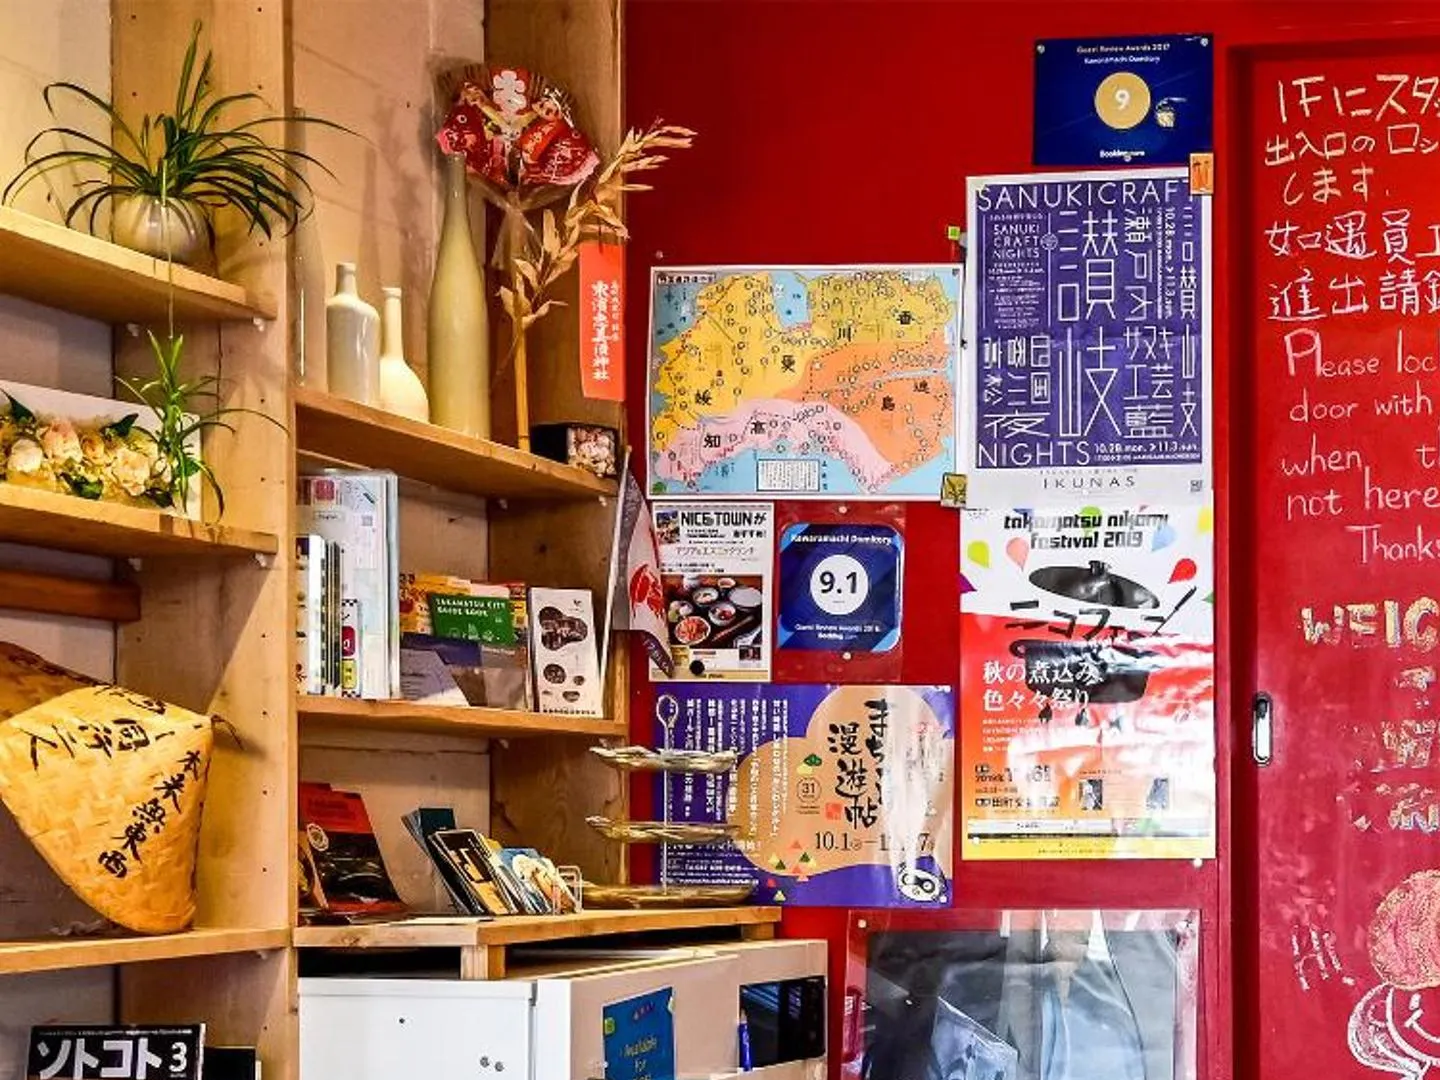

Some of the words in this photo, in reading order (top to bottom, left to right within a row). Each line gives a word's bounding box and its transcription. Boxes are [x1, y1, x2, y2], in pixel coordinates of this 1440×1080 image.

[1115, 89, 1130, 110] 9
[994, 223, 1040, 235] SANUKI
[993, 247, 1040, 259] NIGHTS
[994, 235, 1040, 248] CRAFT
[1284, 328, 1380, 378] Please
[1289, 389, 1359, 423] door
[1374, 380, 1434, 416] with
[978, 440, 1091, 468] NIGHTS
[1281, 432, 1363, 477] when
[1044, 476, 1136, 490] IKUNAS
[1286, 489, 1344, 521] not
[1004, 509, 1103, 532] takamatsu
[1031, 532, 1099, 550] festival
[1103, 531, 1144, 549] 2019
[819, 571, 859, 595] 9.1
[983, 656, 1104, 686] 秋の煮込み
[801, 782, 816, 796] 31
[37, 1037, 163, 1080] ソトコト
[169, 1041, 188, 1073] 3
